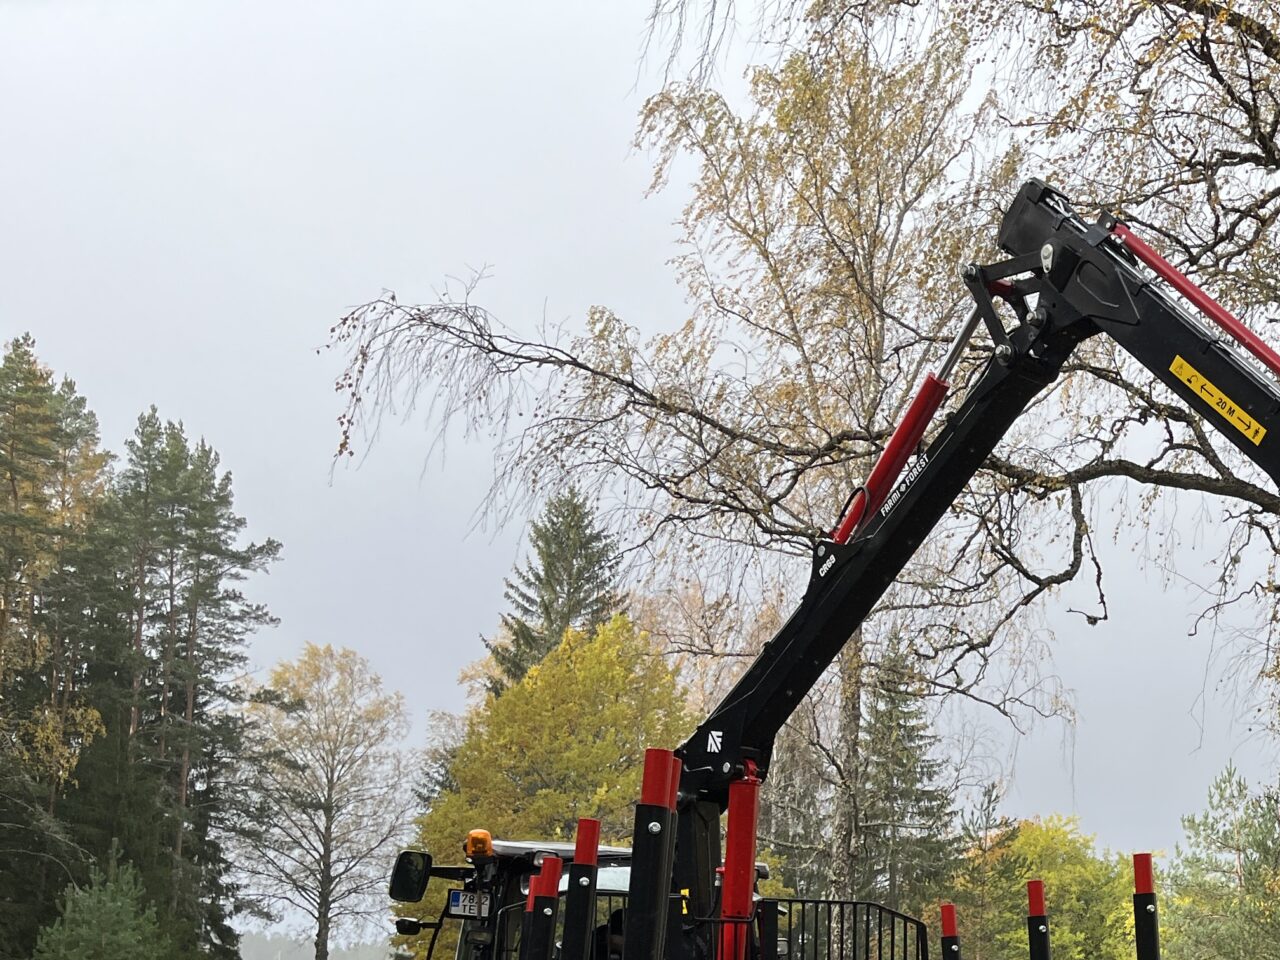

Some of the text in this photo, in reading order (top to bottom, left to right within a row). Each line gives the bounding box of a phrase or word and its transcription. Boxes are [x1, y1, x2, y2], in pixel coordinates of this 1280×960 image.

[1216, 398, 1235, 417] 20 M
[880, 453, 929, 517] FARMI FOREST
[819, 554, 836, 577] CR69
[462, 904, 477, 914] TE
